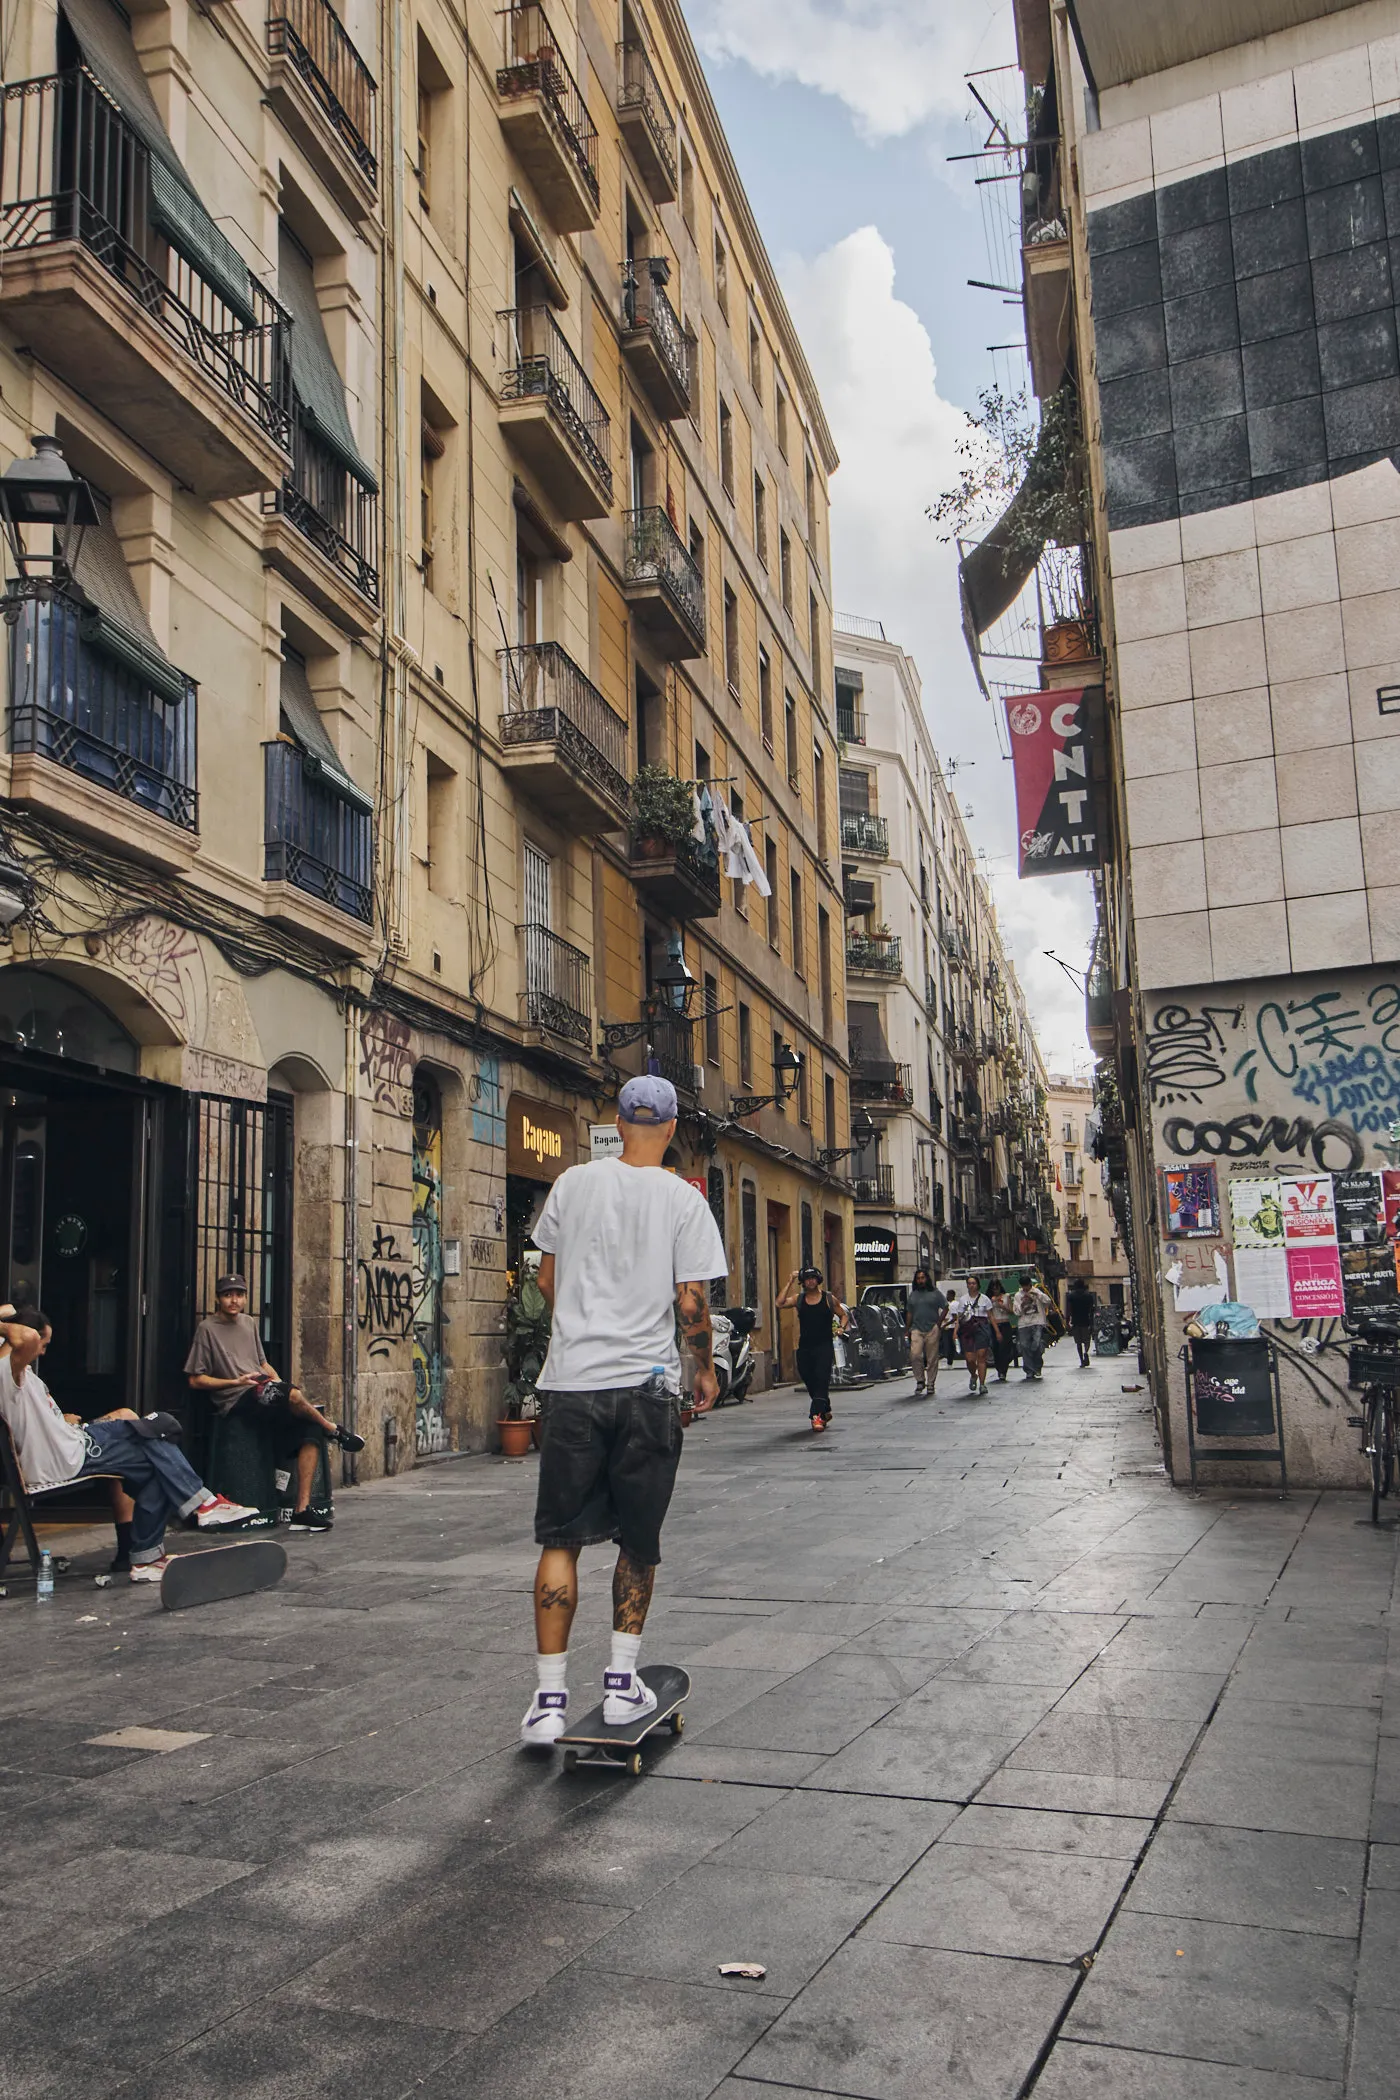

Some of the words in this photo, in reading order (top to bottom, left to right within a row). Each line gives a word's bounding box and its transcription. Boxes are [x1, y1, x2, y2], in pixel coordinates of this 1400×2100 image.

[1050, 702, 1088, 825] CNT
[1053, 833, 1096, 856] AIT
[522, 1115, 562, 1163] Bagana
[1163, 1114, 1365, 1173] COSMO
[1294, 1279, 1337, 1287] ANTIGA
[607, 1677, 622, 1686] NIKE
